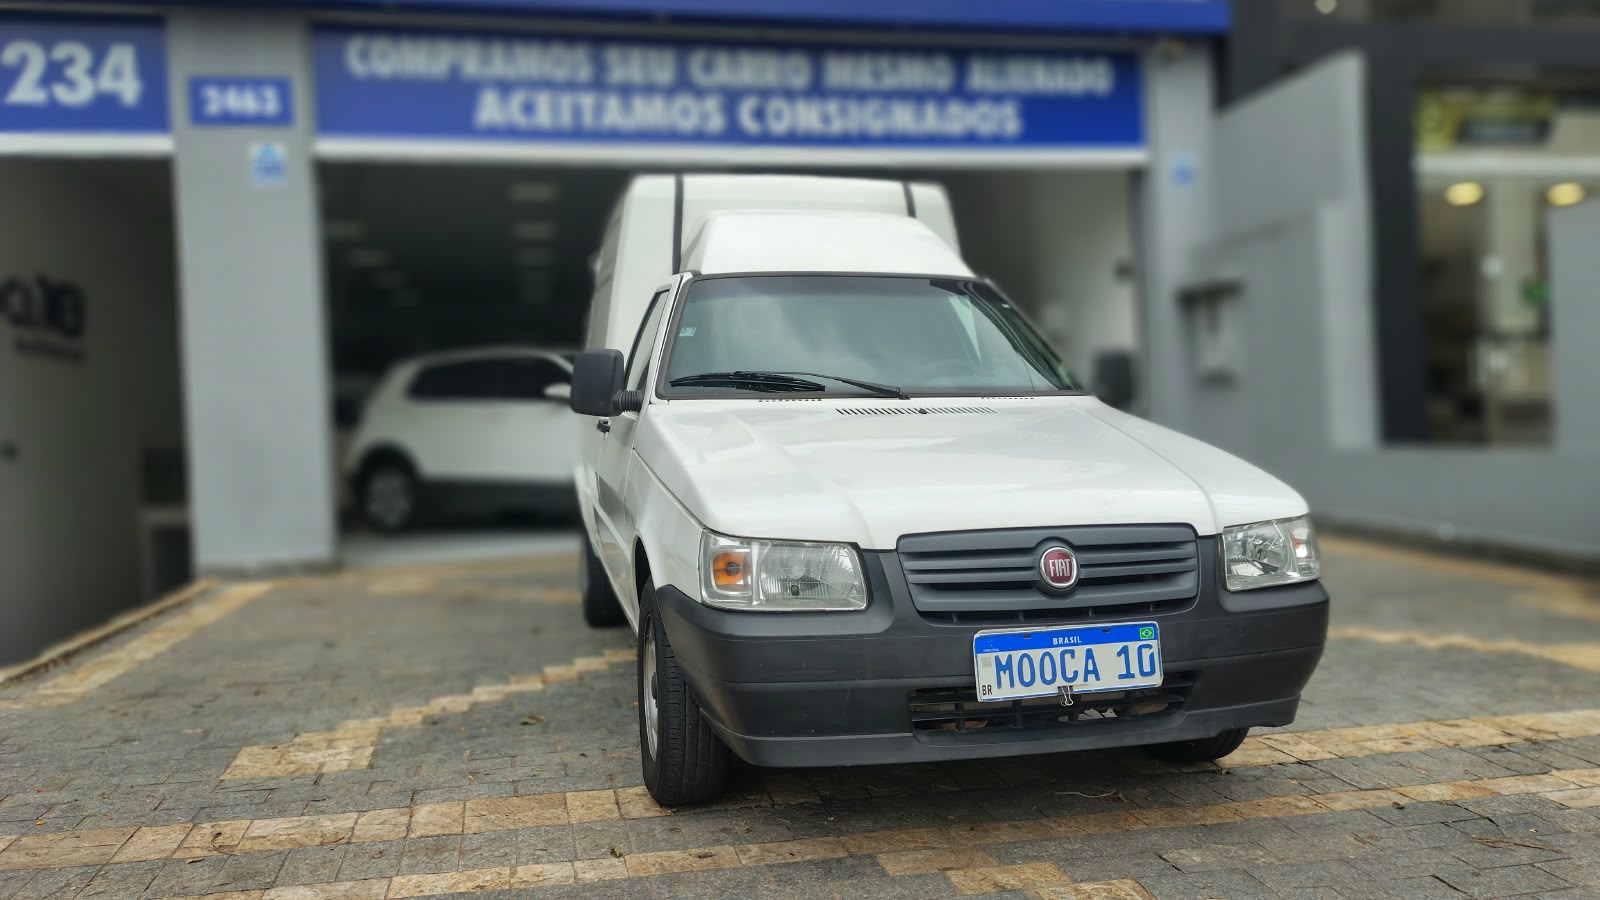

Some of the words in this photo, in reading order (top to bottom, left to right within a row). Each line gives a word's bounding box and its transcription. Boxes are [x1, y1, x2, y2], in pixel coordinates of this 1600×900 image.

[2, 40, 142, 106] 234
[345, 35, 594, 82] COMPRAMOS
[604, 45, 676, 85] SEU
[689, 49, 811, 89] CARRO
[823, 52, 955, 92] MESMO
[967, 55, 1114, 96] ALIENADO
[475, 89, 725, 134] ACEITAMOS
[738, 96, 1023, 138] CONSIGNADOS
[1049, 559, 1071, 577] FIAT
[1052, 636, 1082, 645] BRASIL
[994, 648, 1101, 689] MOOCA
[1116, 643, 1156, 680] 10
[981, 684, 993, 696] BR
